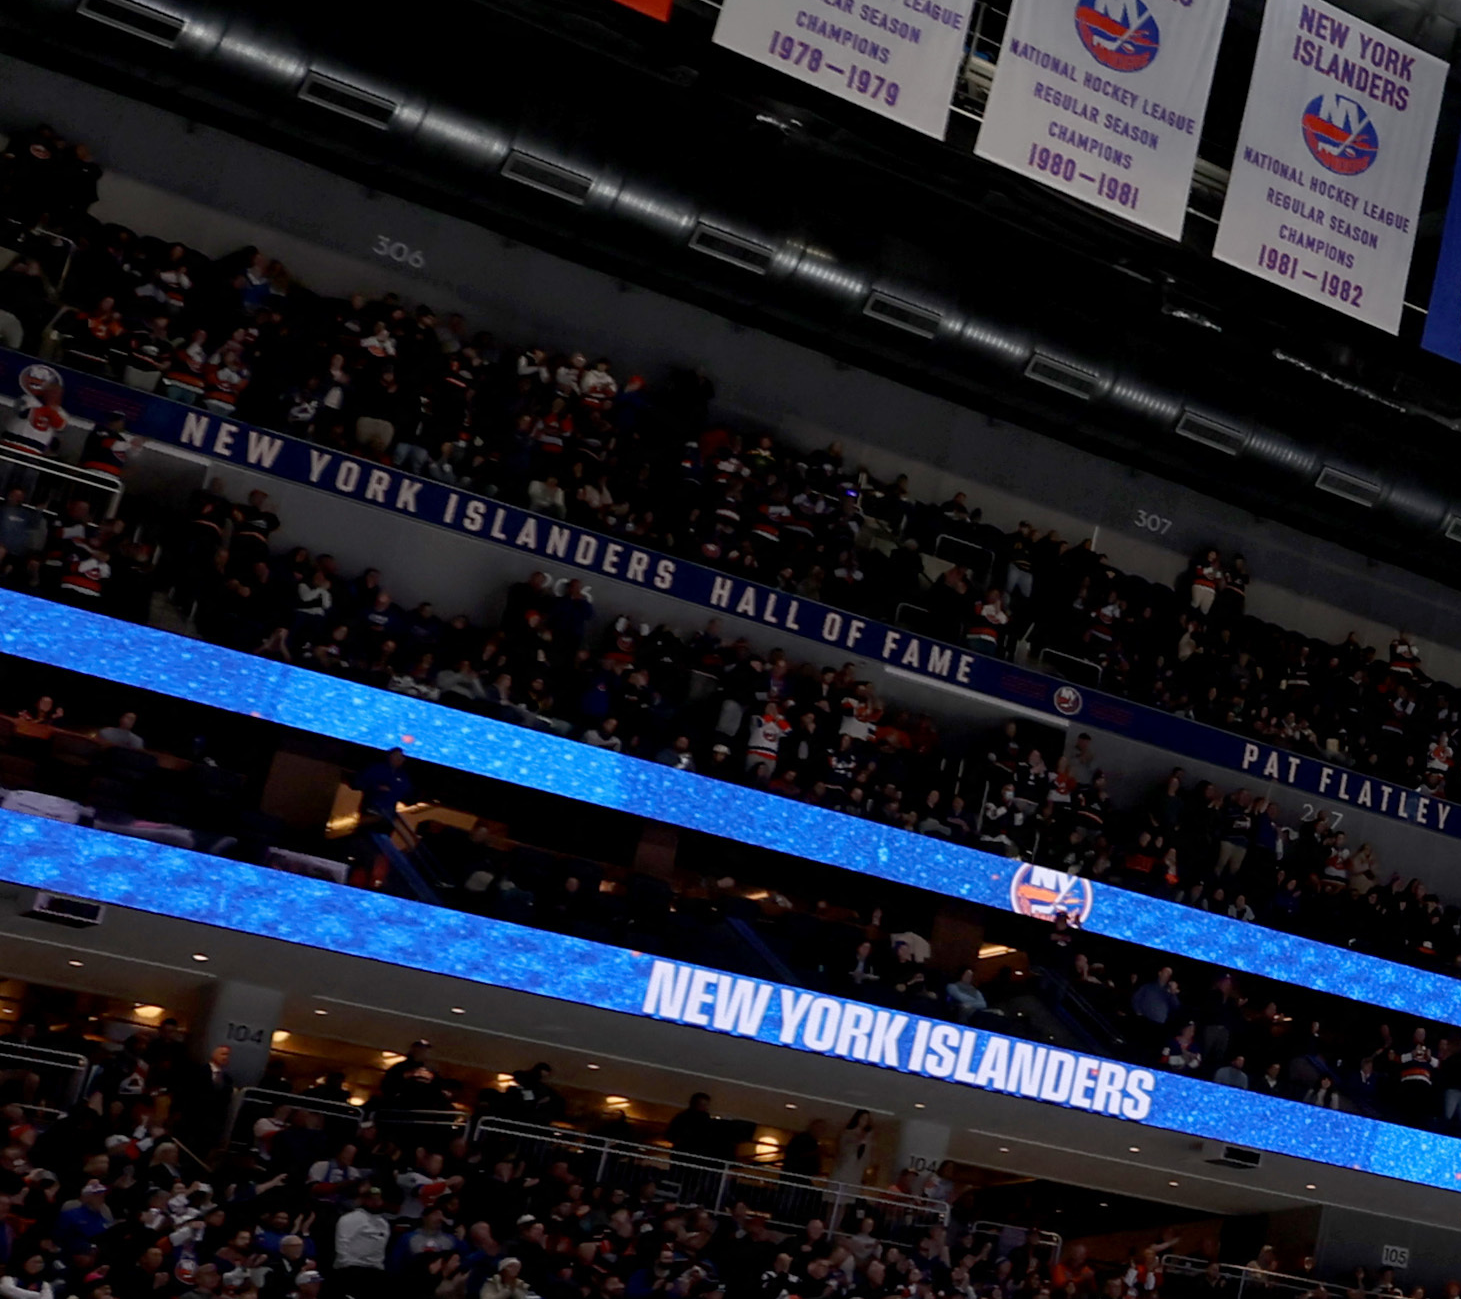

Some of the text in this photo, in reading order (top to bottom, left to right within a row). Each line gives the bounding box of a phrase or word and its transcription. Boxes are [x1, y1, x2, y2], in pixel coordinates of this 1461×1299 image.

[794, 7, 892, 67] CHAMPIONS
[858, 1, 923, 46] SEASON
[373, 234, 424, 270] 306
[1134, 509, 1172, 534] 307
[180, 410, 974, 686] NEW YORK ISLANDERS HALL OF FAME
[1242, 742, 1452, 830] PAT FLATLEY
[226, 1020, 264, 1046] 104
[642, 959, 1156, 1123] NEW YORK ISLANDERS
